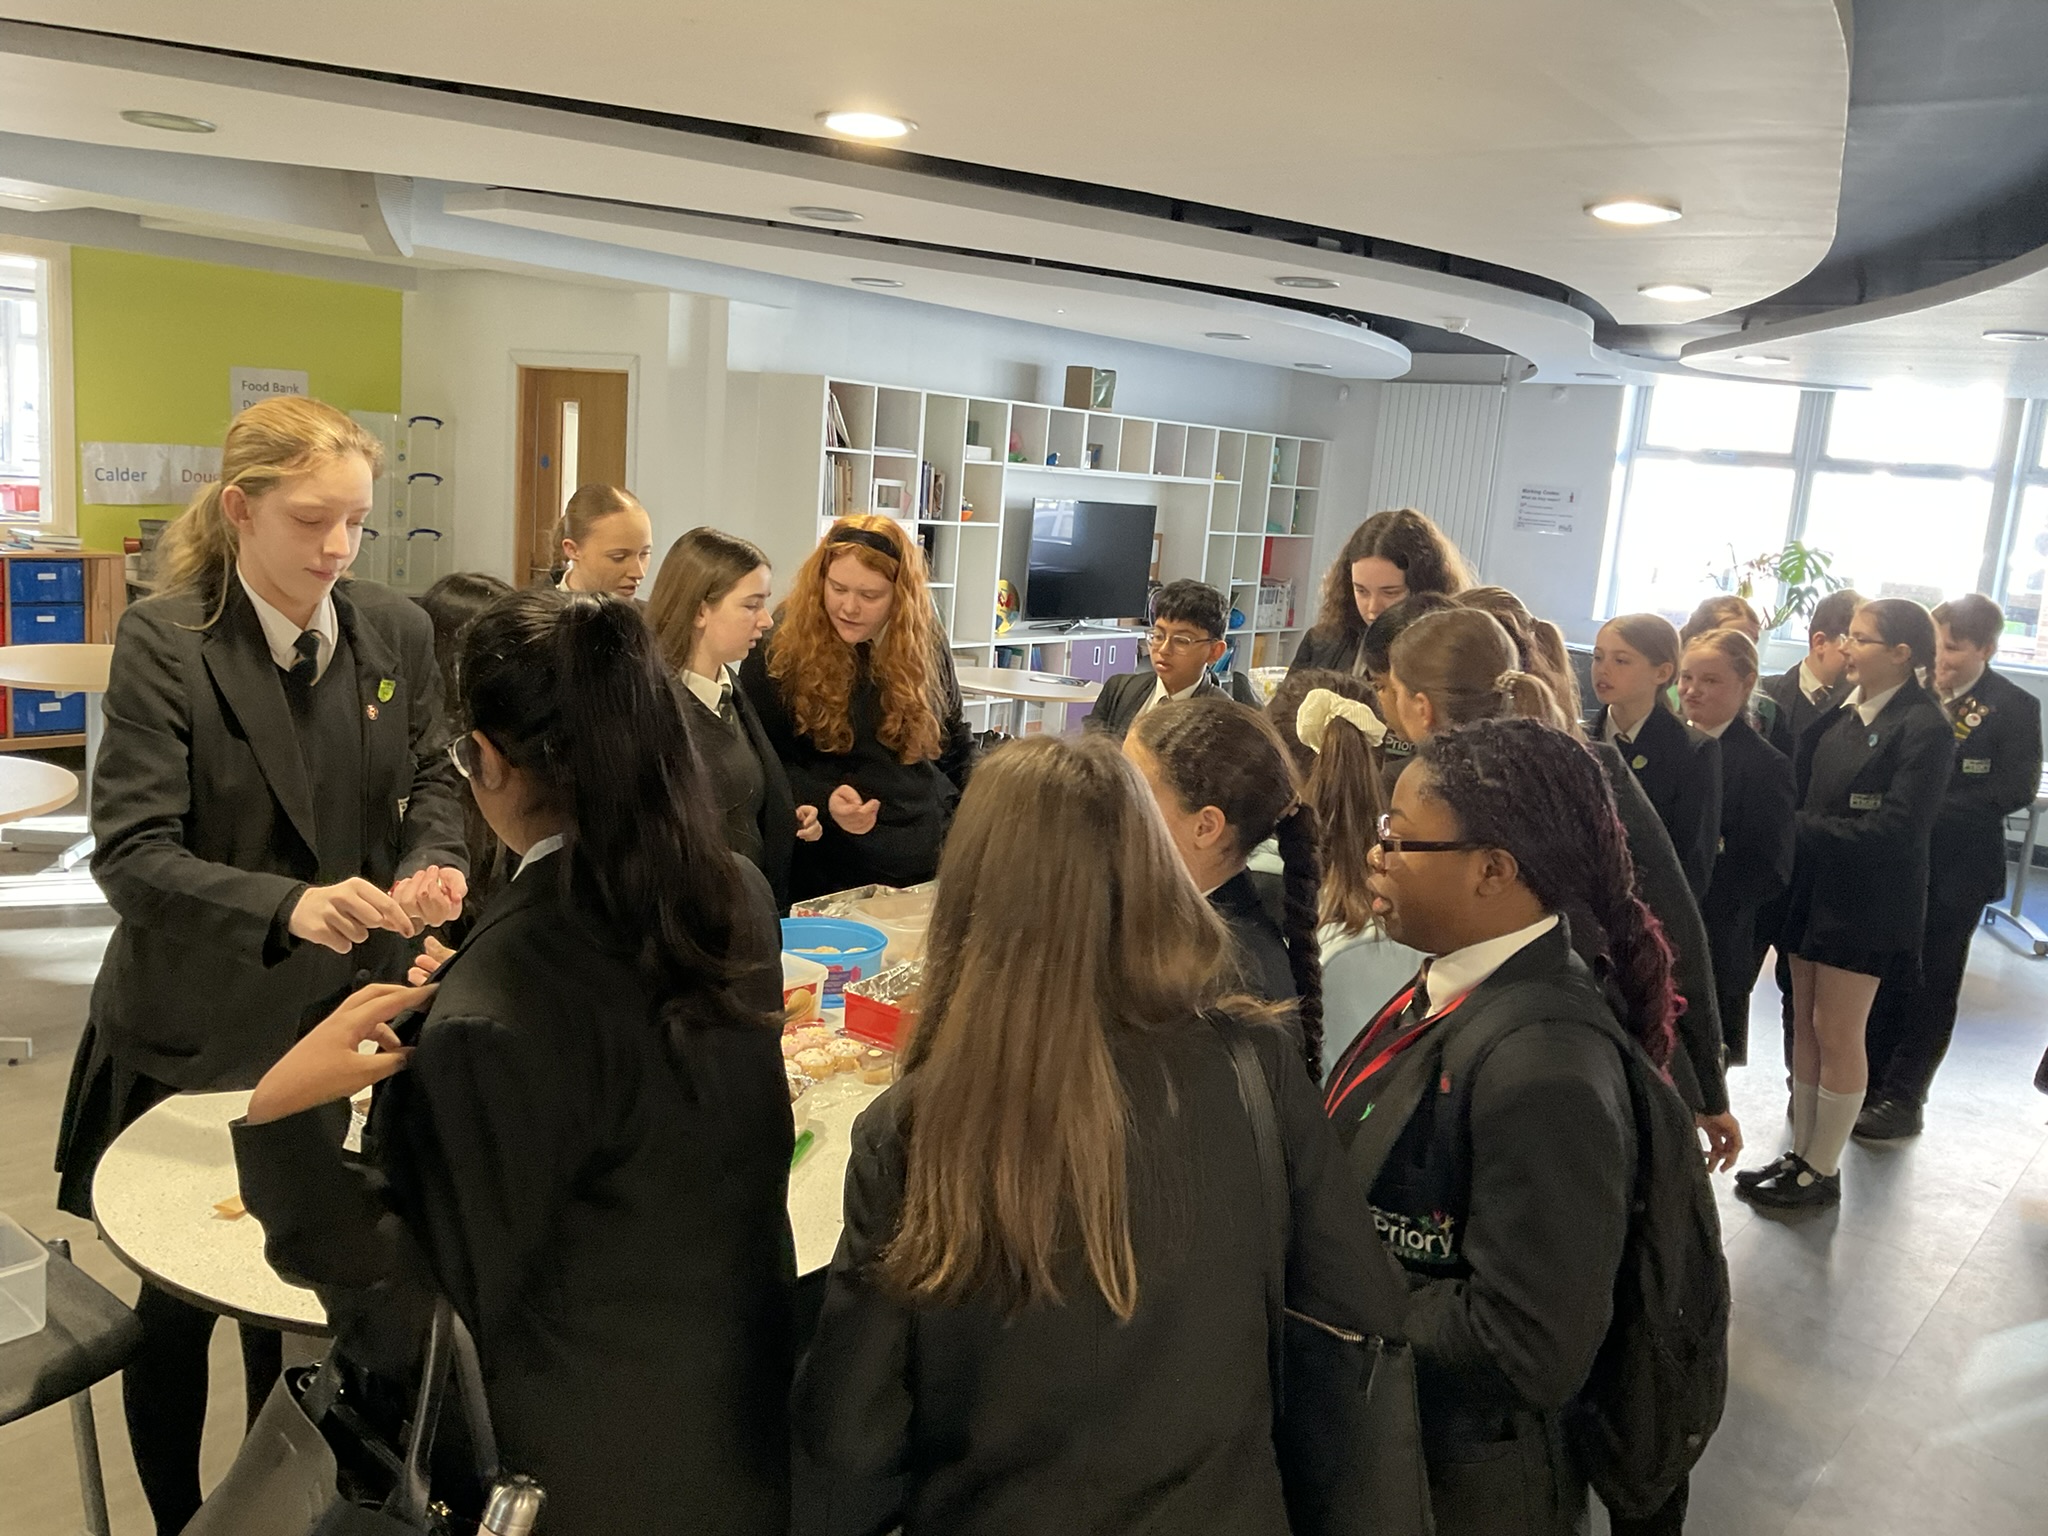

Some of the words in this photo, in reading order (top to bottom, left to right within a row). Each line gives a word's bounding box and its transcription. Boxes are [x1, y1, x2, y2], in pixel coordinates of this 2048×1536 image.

[241, 380, 270, 392] Food
[272, 382, 300, 394] Bank
[94, 467, 147, 482] Calder
